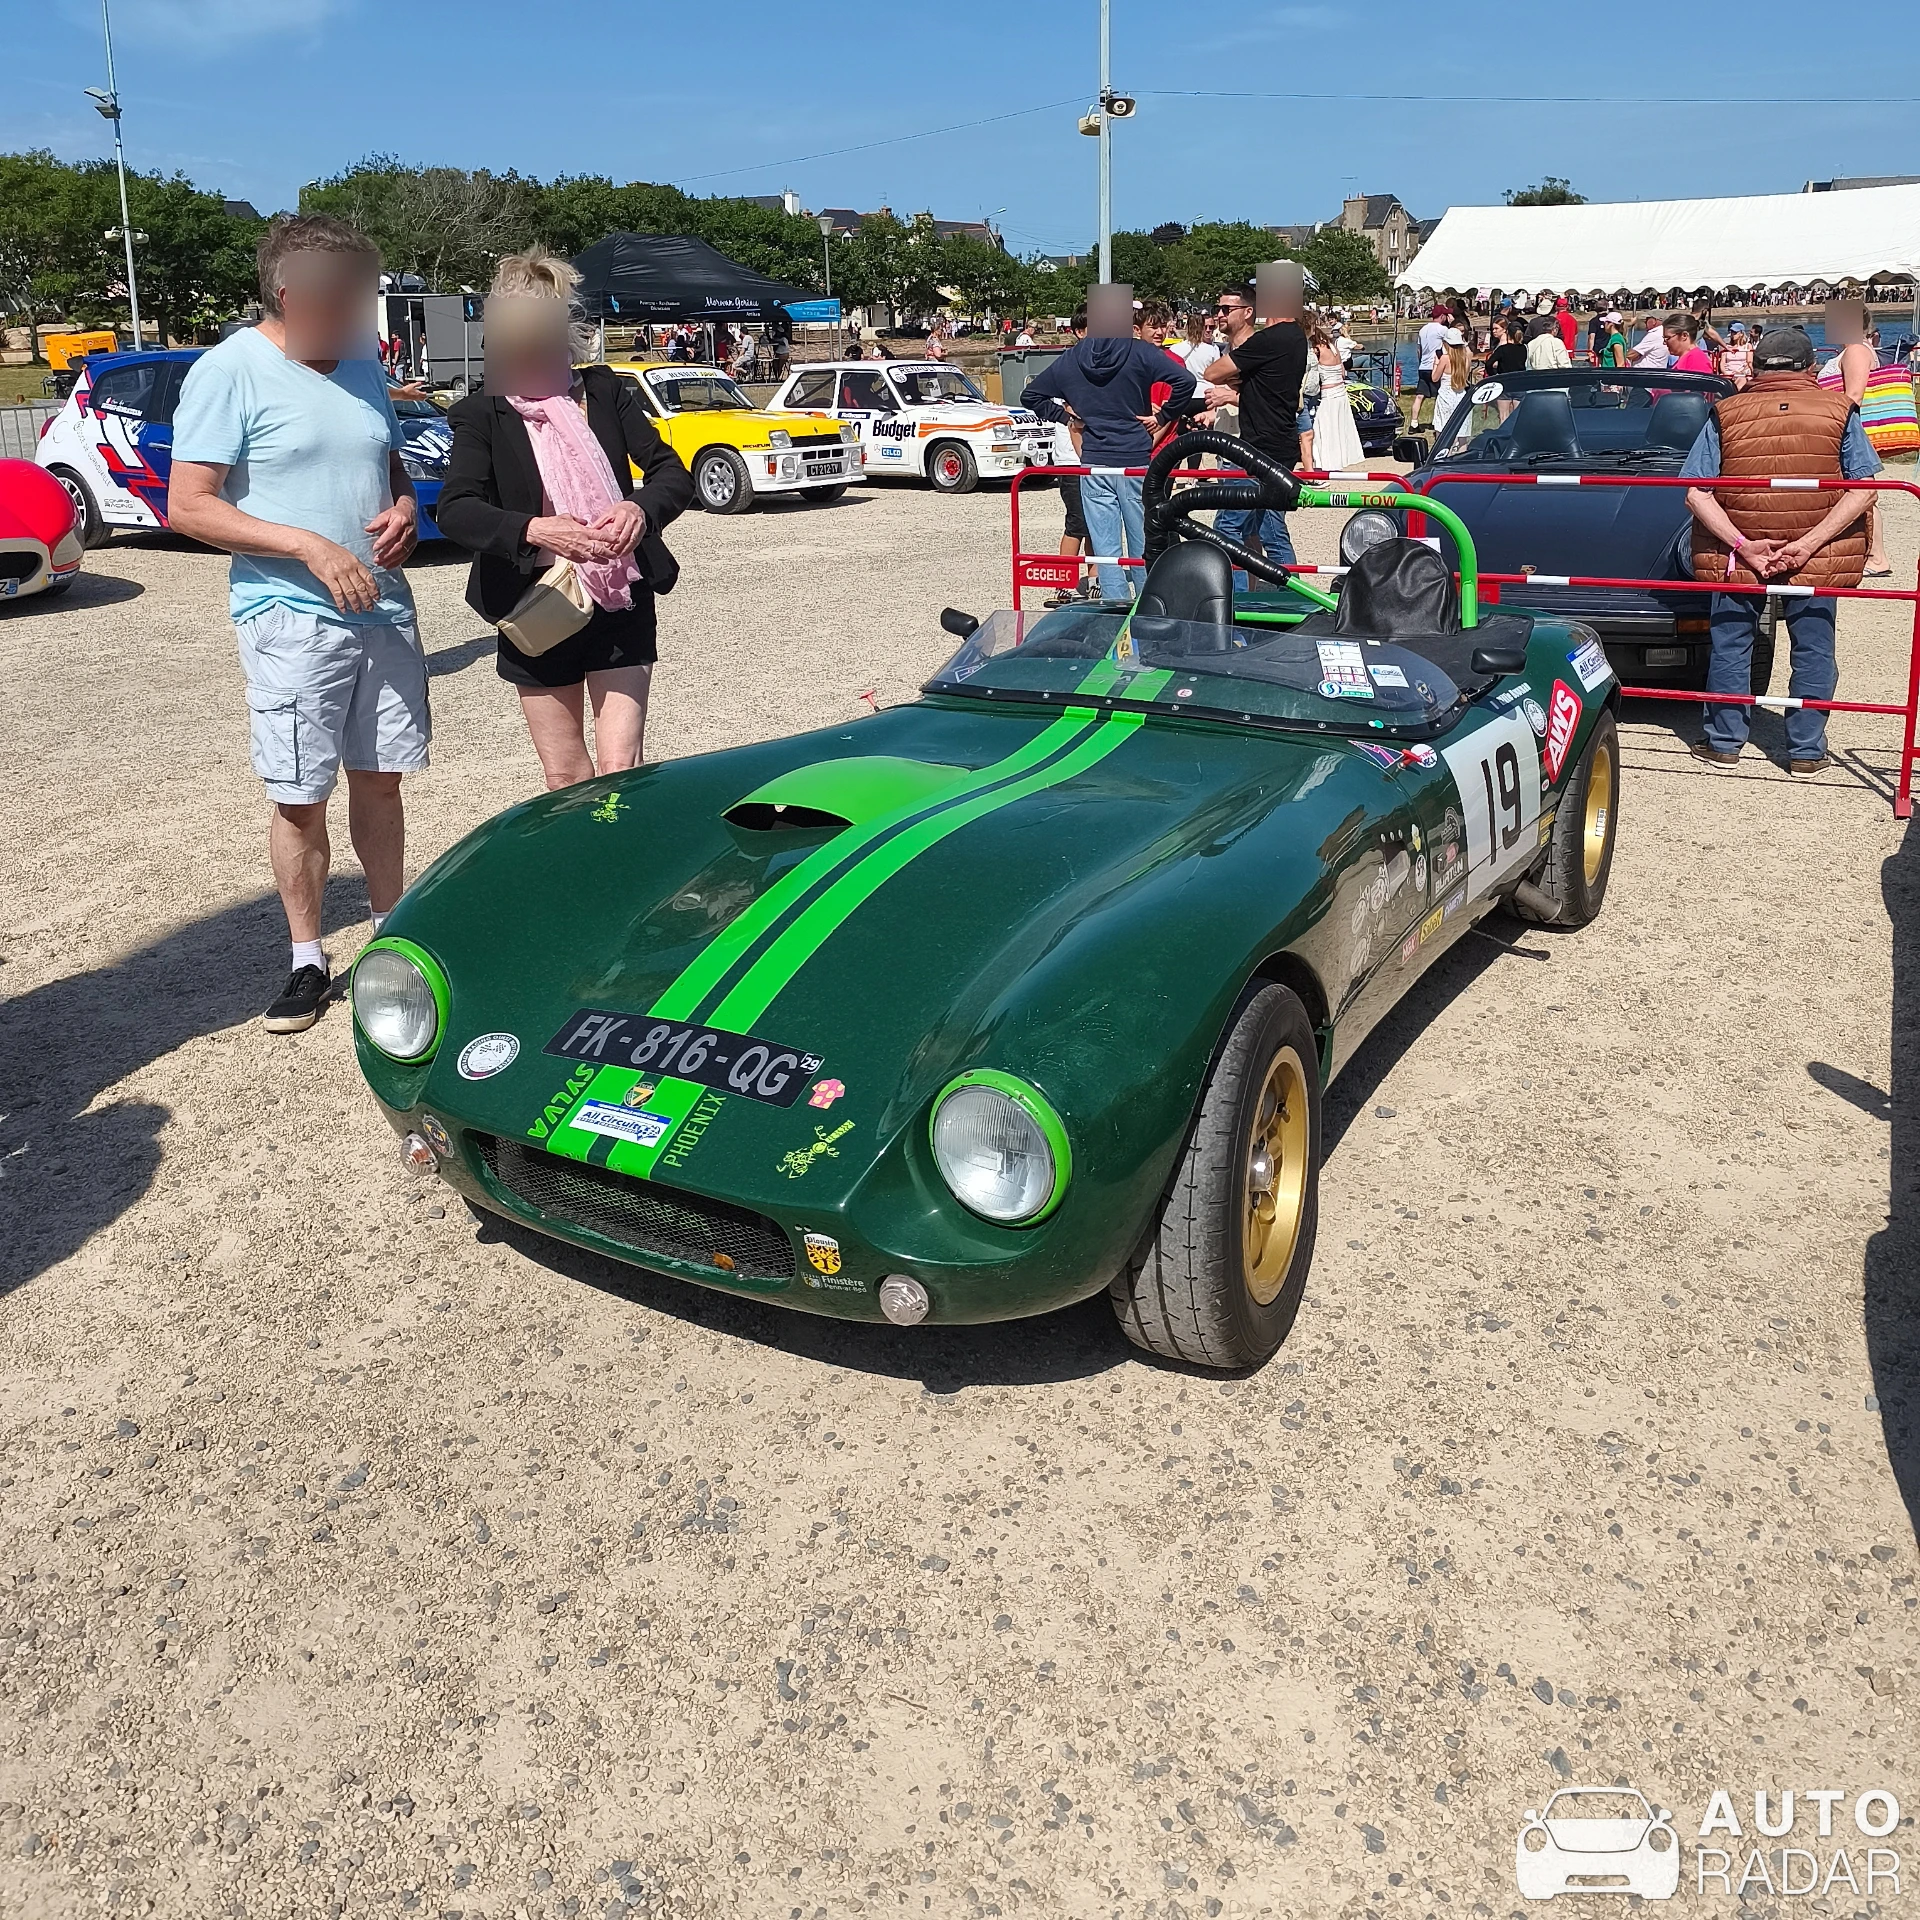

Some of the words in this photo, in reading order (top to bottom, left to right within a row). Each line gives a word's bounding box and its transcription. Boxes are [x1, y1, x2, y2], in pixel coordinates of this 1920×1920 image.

[899, 366, 937, 374] RENAULT
[873, 419, 916, 441] Budget
[1331, 493, 1348, 506] TOW
[1361, 494, 1398, 507] TOW
[1026, 567, 1072, 582] CEGELEC
[1548, 689, 1578, 776] AWS
[1481, 741, 1521, 866] 19
[562, 1015, 797, 1096] FK-816-QG
[801, 1057, 820, 1072] 29
[527, 1063, 594, 1138] SYLVA
[583, 1111, 601, 1120] All
[663, 1093, 727, 1168] PHOENIX
[821, 1275, 864, 1287] Finistère
